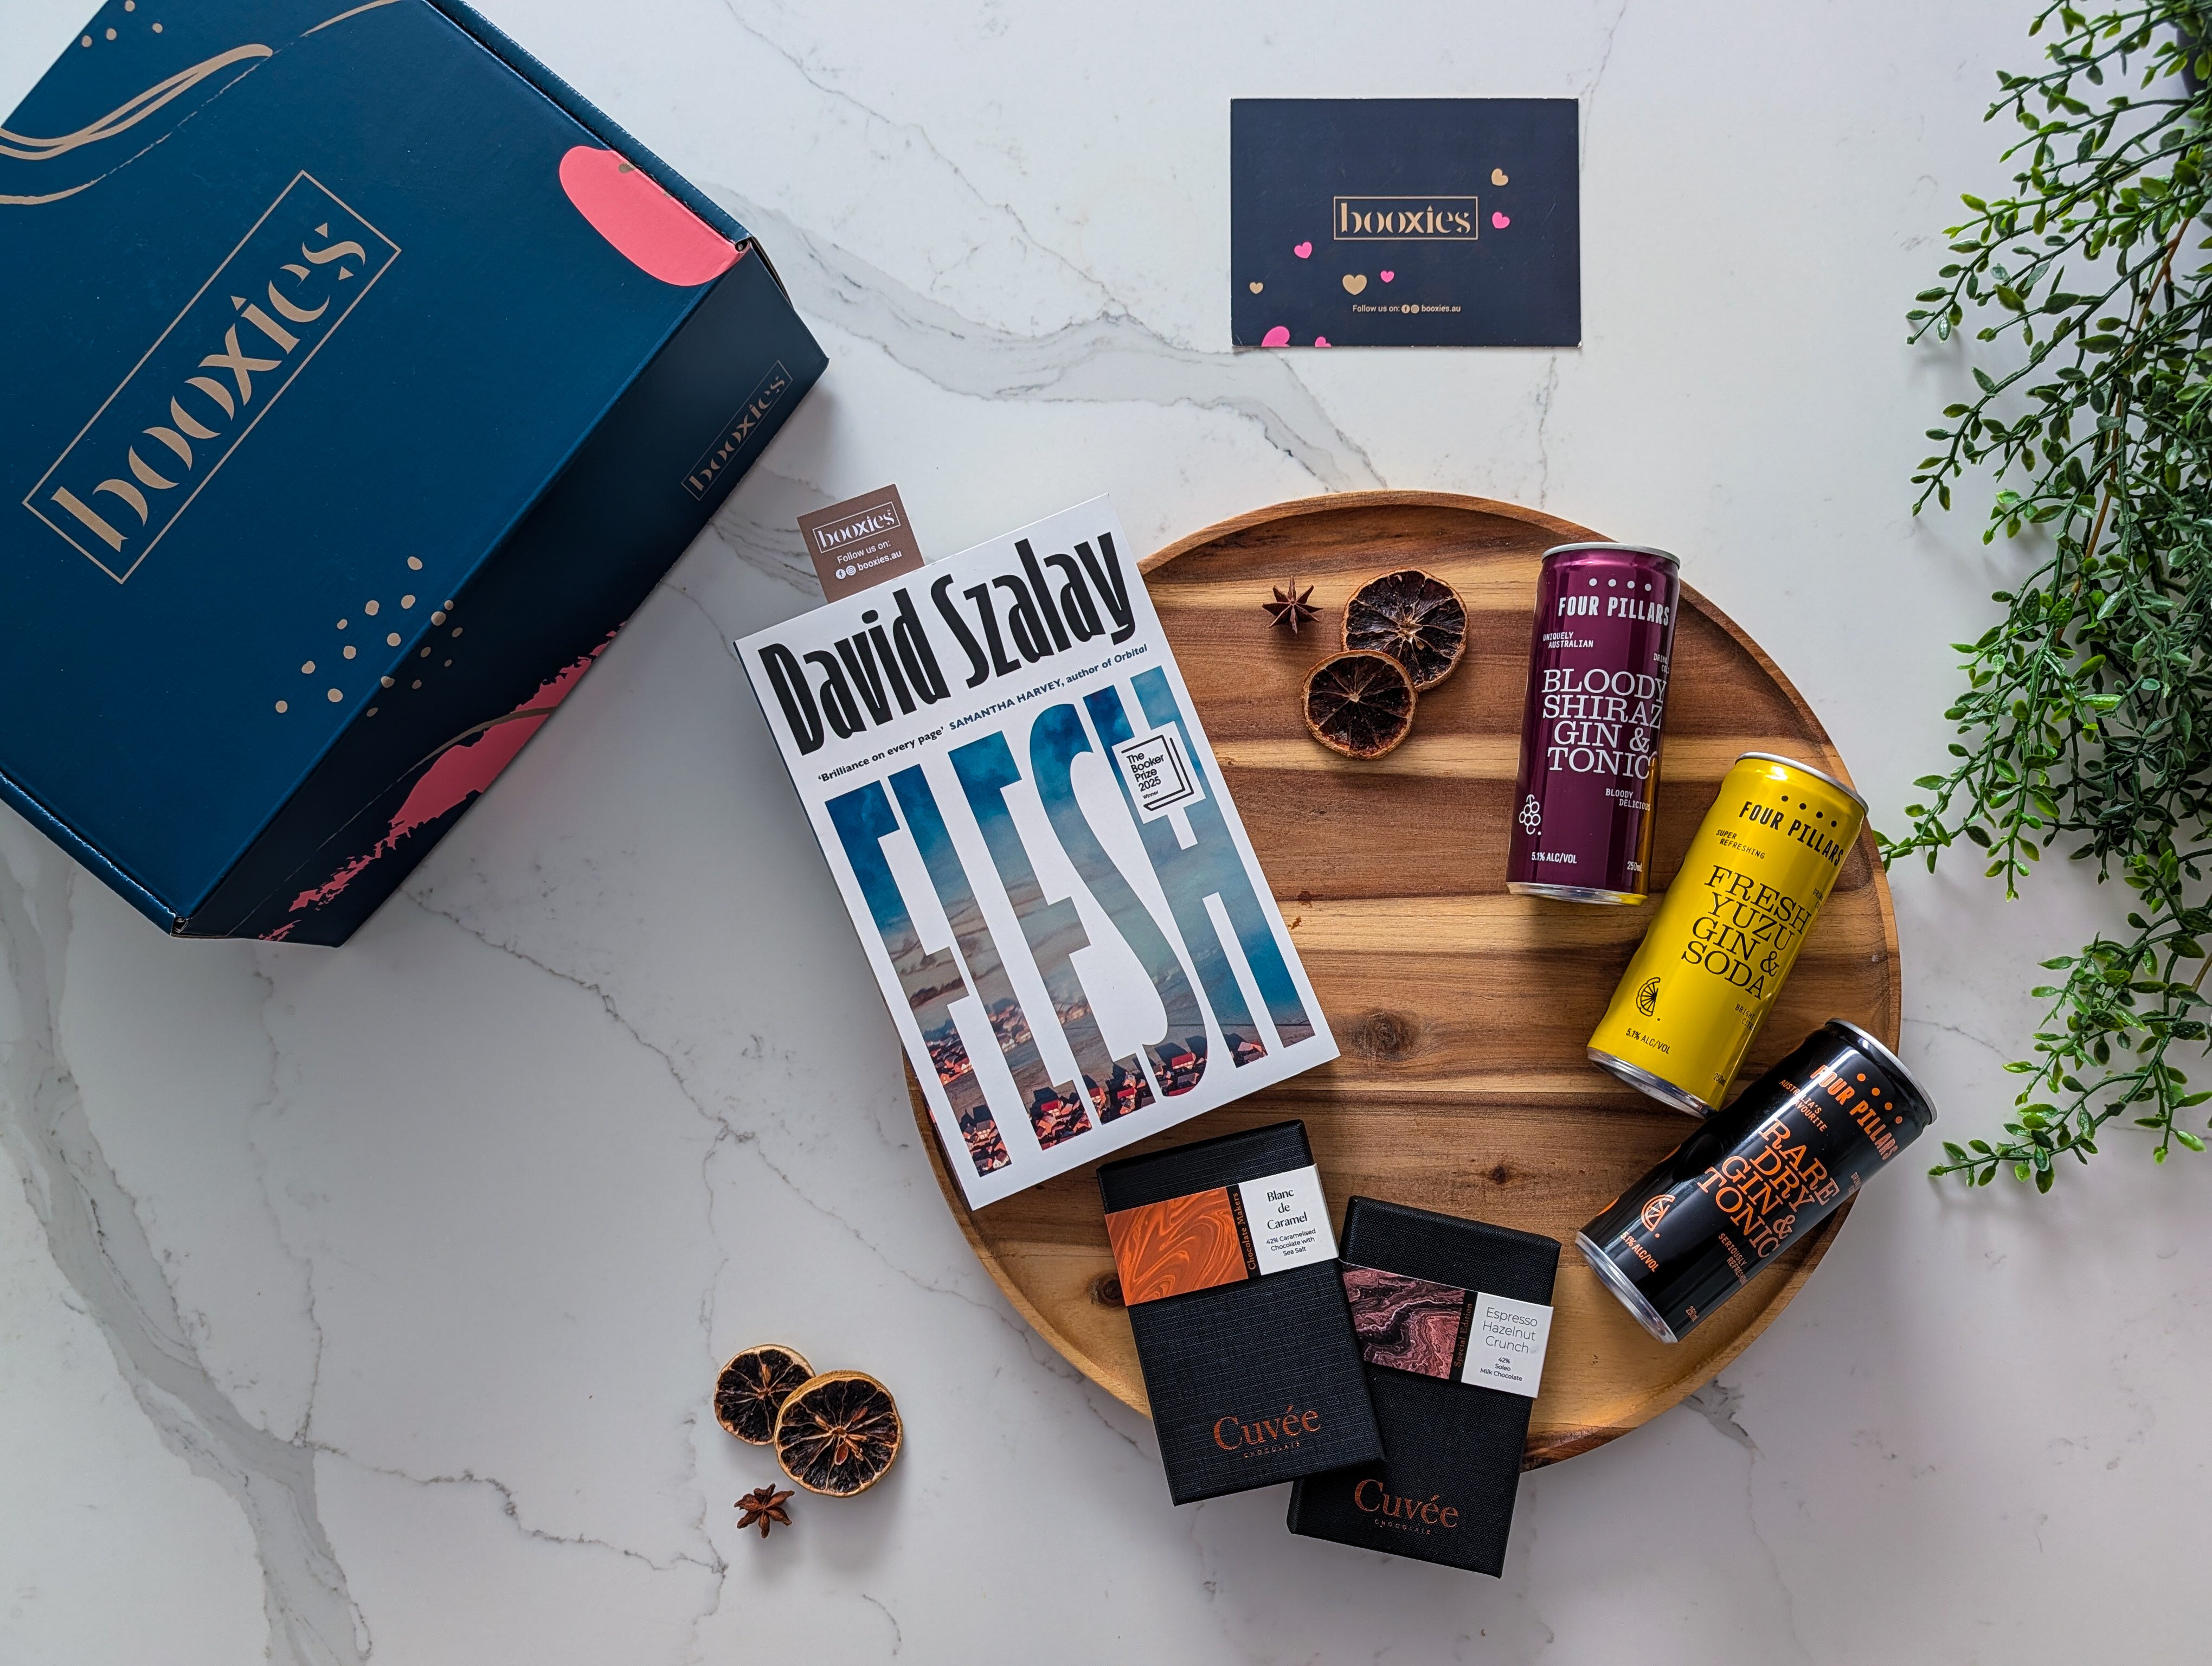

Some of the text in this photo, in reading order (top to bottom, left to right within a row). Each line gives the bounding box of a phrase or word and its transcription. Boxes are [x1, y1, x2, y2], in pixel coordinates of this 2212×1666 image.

[1341, 203, 1471, 233] booxies
[50, 222, 365, 552] booxies
[689, 376, 785, 491] booxies
[818, 512, 895, 548] booxies
[837, 549, 864, 564] Follow
[878, 540, 891, 549] on:
[857, 550, 902, 571] booxies.au
[1558, 596, 1670, 626] FOUR PILLARS
[758, 531, 1136, 755] David Szalay
[1543, 631, 1574, 642] UNIQUELY
[1548, 640, 1594, 649] AUSTRALIAN
[1541, 668, 1667, 703] BLOODY
[872, 752, 885, 761] on
[887, 739, 915, 755] every
[949, 699, 1015, 731] SAMANTHA
[1016, 678, 1065, 704] HARVEY,
[1066, 665, 1099, 683] author
[1101, 658, 1113, 669] of
[1114, 644, 1148, 663] Orbital
[1542, 694, 1663, 730] SHIRAZ
[1554, 721, 1650, 753] GIN &
[1126, 753, 1145, 765] The
[1130, 754, 1165, 773] Booker
[1547, 747, 1651, 780] TONIC
[1134, 768, 1158, 783] Prize
[1138, 776, 1161, 792] 2025
[1142, 790, 1159, 799] Winner
[1605, 788, 1634, 798] BLOODY
[1619, 799, 1651, 811] DELICIOUS
[1716, 829, 1738, 840] SUPER
[1719, 838, 1766, 860] REFRESHING
[1739, 801, 1844, 867] FOUR PILLARS
[1531, 851, 1578, 864] 5.1% ALC/VOL
[1704, 865, 1811, 935] FRESH
[824, 665, 1316, 1177] FLESH
[1708, 892, 1795, 951] YUZU
[1692, 917, 1780, 977] GIN &
[1681, 940, 1765, 1000] SODA
[1735, 1004, 1756, 1021] BRIGHT
[1626, 1028, 1671, 1055] 5.1% ALC/VOL
[1779, 1079, 1822, 1114] AUSTRLIA'S
[1792, 1098, 1828, 1132] AVOURITE
[1849, 1100, 1898, 1161] PILLARS
[1758, 1118, 1840, 1206] RARE
[1750, 1145, 1815, 1212] DRY
[1266, 1189, 1295, 1202] Blanc
[1278, 1202, 1291, 1214] de
[1722, 1156, 1796, 1240] GIN &
[1267, 1212, 1308, 1230] Caramel
[1697, 1167, 1780, 1258] TONIC
[1233, 1193, 1256, 1270] Chocolate Makers
[1271, 1236, 1315, 1252] Chocolate with
[1279, 1228, 1316, 1242] Caramelised
[1620, 1231, 1659, 1272] 5.1% ALC/VOL
[1718, 1233, 1747, 1266] SERIOUSLY
[1483, 1321, 1536, 1341] Hazelnut
[1486, 1306, 1538, 1327] Espresso
[1454, 1303, 1472, 1367] Special Edition
[1486, 1336, 1529, 1354] Crunch
[1494, 1370, 1523, 1381] Chocolate
[1495, 1363, 1511, 1372] Soleo
[1213, 1404, 1321, 1451] Cuvée
[1354, 1479, 1459, 1528] Cuvée
